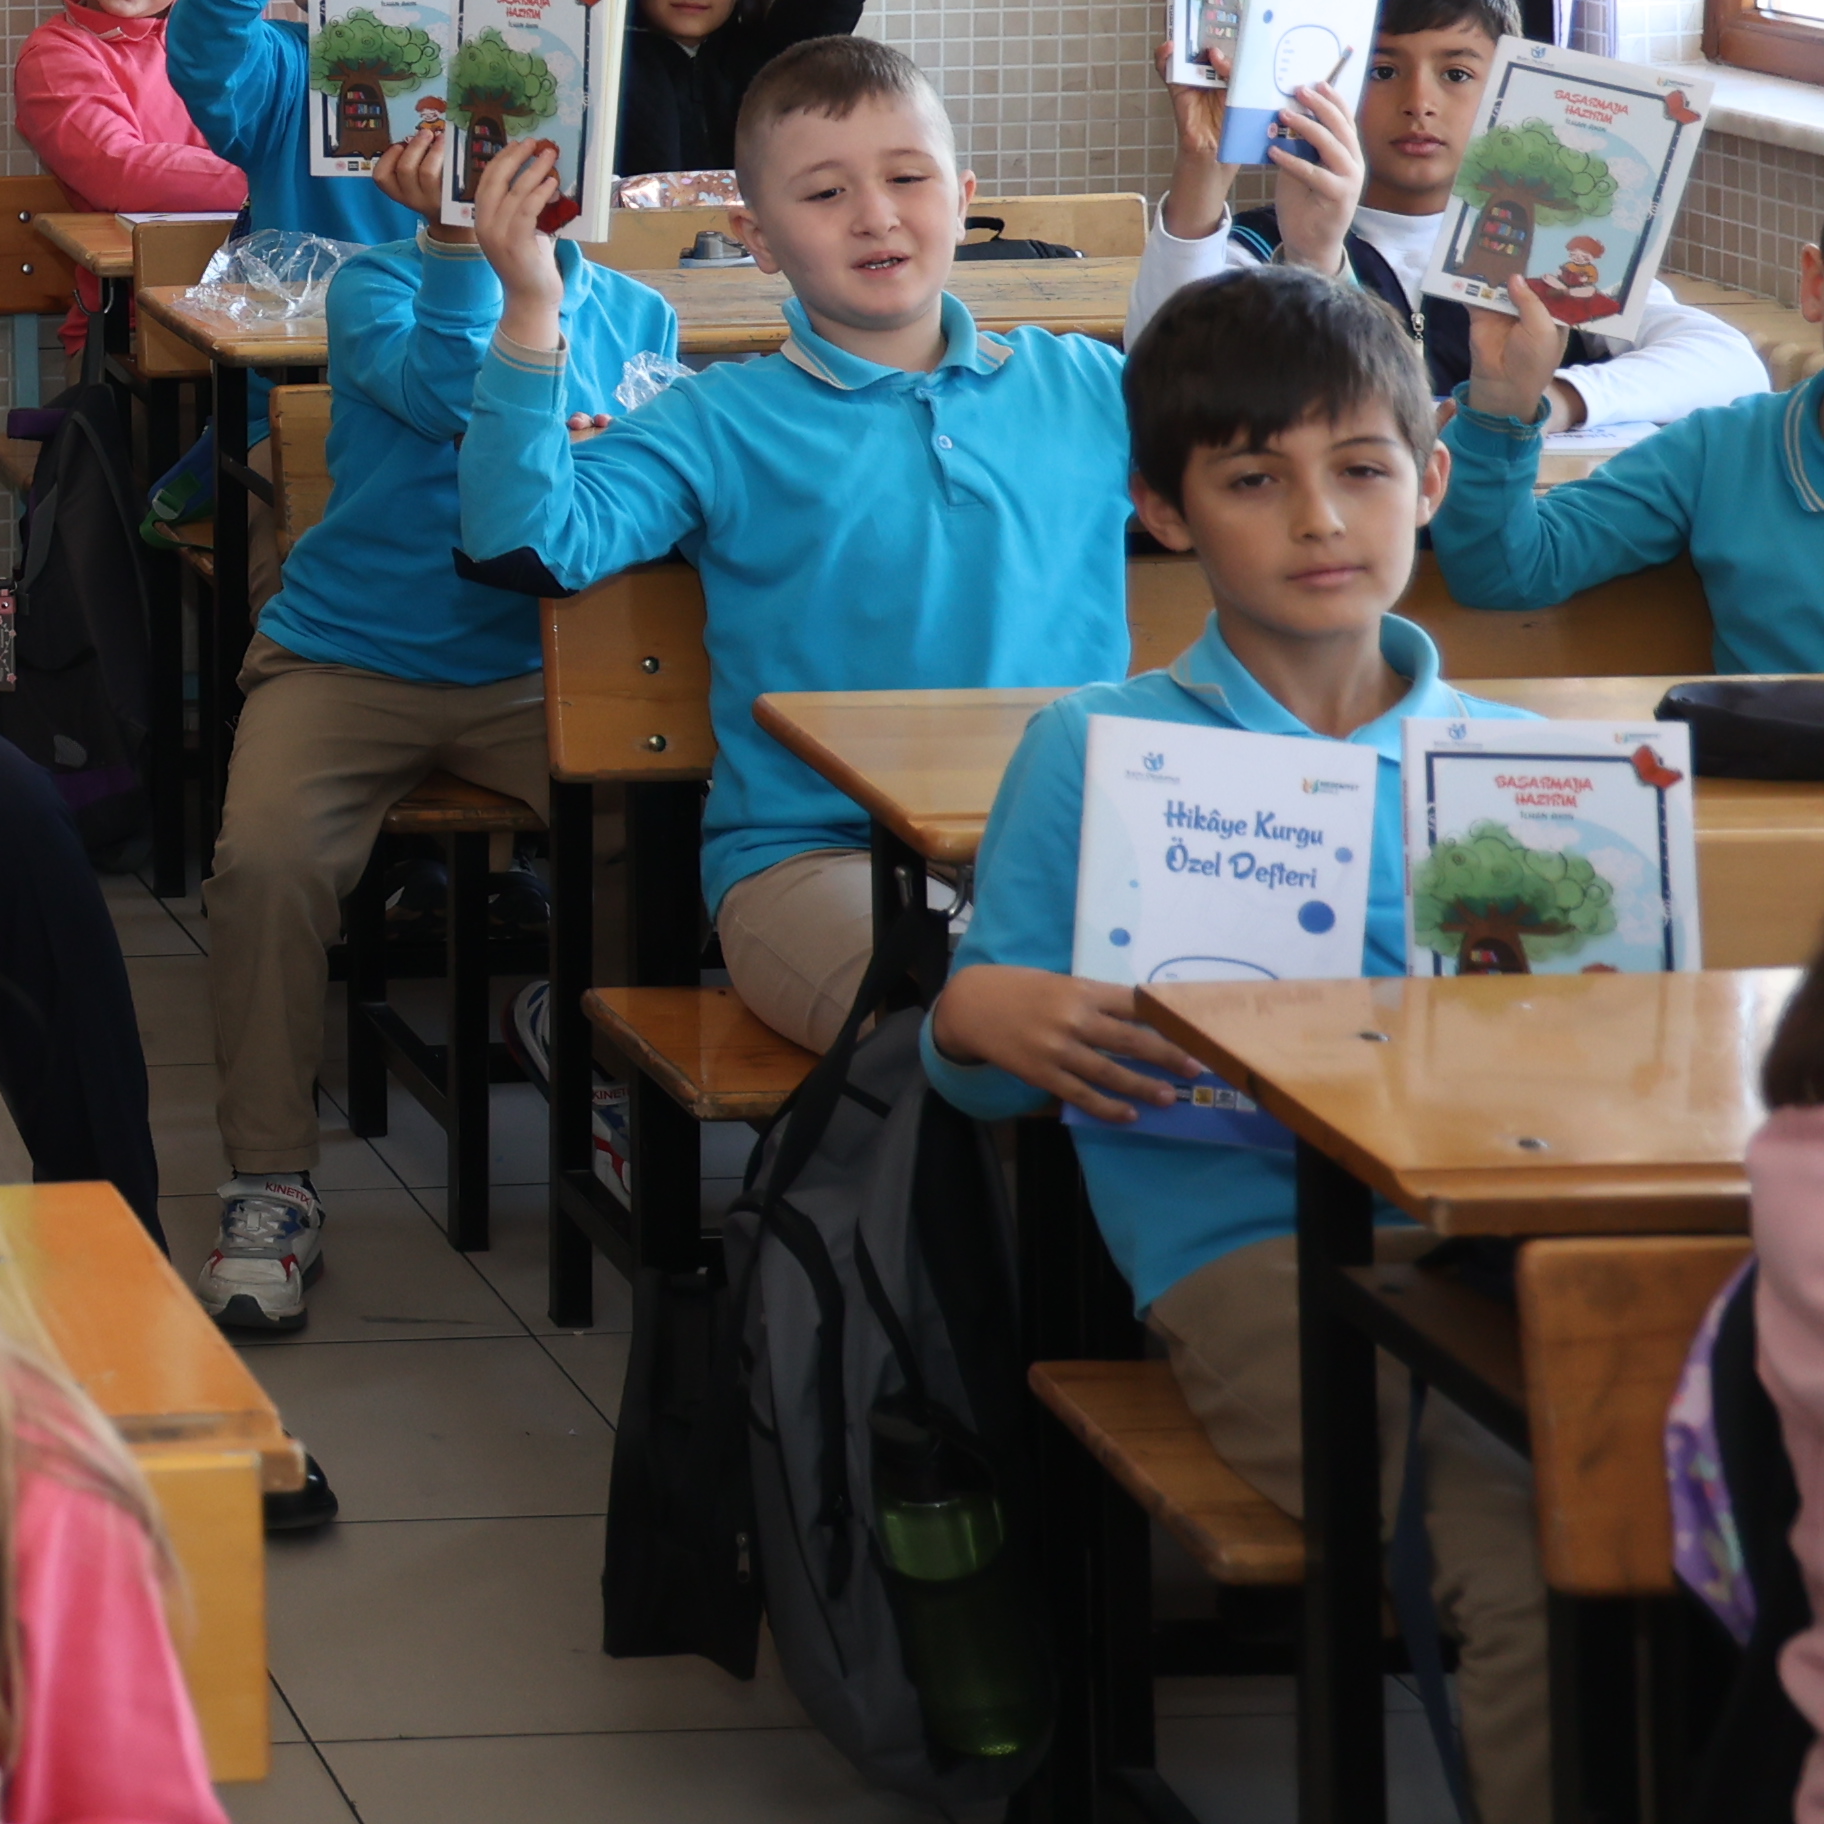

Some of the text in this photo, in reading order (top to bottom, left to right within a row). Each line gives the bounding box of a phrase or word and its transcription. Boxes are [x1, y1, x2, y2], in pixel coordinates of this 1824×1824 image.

[1515, 793, 1578, 808] HAZIRIM
[1163, 799, 1324, 849] Hikâye Kurgu
[1165, 837, 1318, 890] Özel Defteri
[592, 1087, 630, 1100] KINET
[265, 1182, 310, 1205] KINETIX
